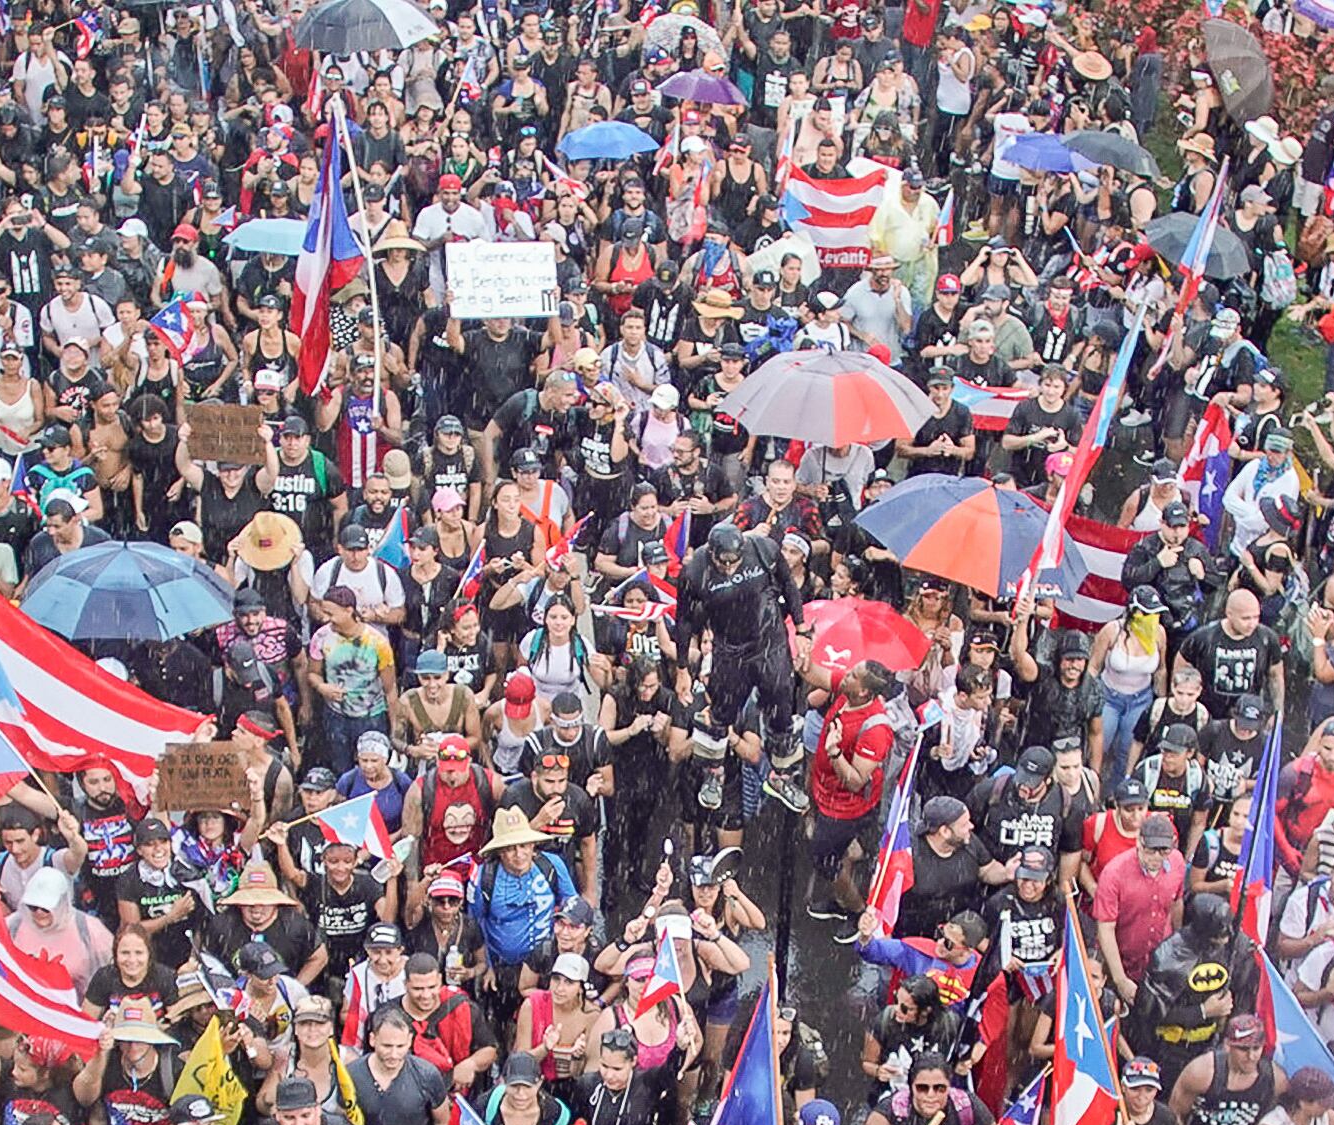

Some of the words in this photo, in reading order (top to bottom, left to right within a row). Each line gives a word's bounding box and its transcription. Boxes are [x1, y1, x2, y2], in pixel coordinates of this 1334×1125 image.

[274, 475, 316, 494] ustin
[271, 493, 307, 512] 3:16
[1007, 582, 1064, 597] NTICA
[1000, 829, 1054, 847] UPR
